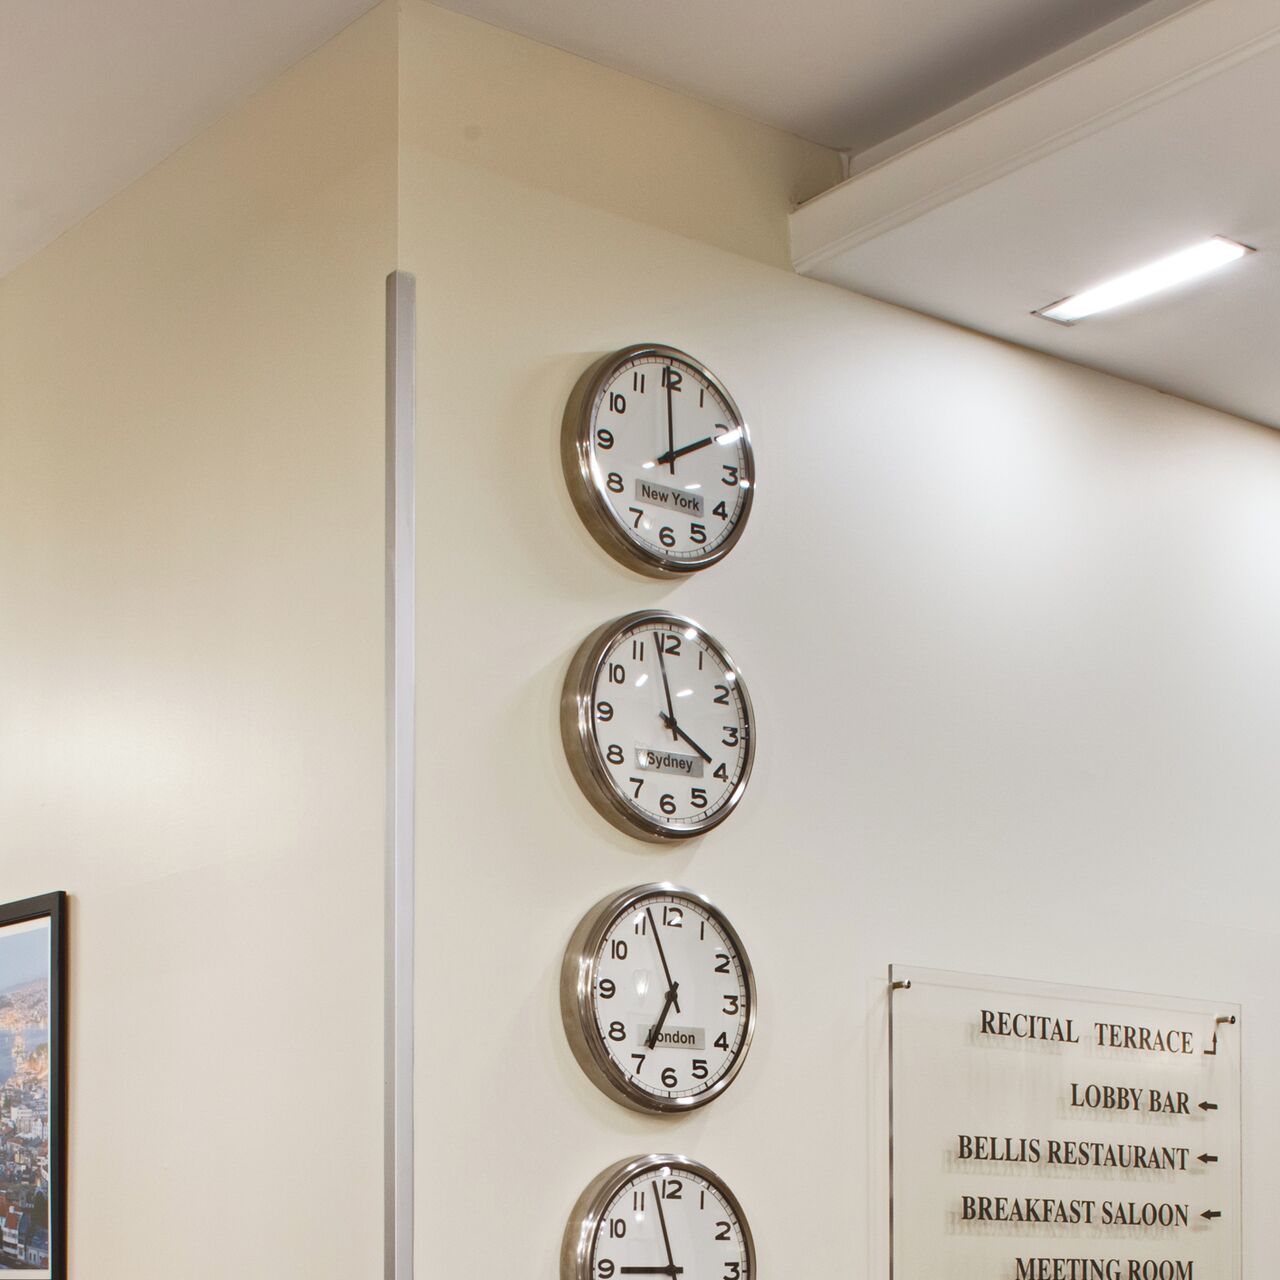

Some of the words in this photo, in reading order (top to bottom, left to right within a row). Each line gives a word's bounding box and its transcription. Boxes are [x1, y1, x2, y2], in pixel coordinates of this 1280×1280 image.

[633, 372, 645, 393] 11
[662, 366, 683, 392] 12
[610, 392, 626, 414] 10
[699, 389, 704, 408] 1
[597, 429, 614, 450] 9
[606, 472, 624, 493] 8
[722, 465, 738, 486] 3
[642, 485, 669, 503] New
[673, 492, 700, 512] York
[629, 507, 643, 528] 7
[712, 501, 728, 520] 4
[659, 527, 676, 547] 6
[689, 523, 707, 544] 5
[633, 640, 644, 661] 11
[660, 633, 681, 656] 12
[699, 651, 703, 670] 1
[609, 663, 625, 684] 10
[714, 685, 730, 705] 2
[596, 701, 614, 722] 9
[722, 726, 738, 747] 3
[607, 744, 624, 765] 8
[647, 752, 693, 773] Sydney
[713, 763, 728, 783] 4
[629, 777, 644, 798] 7
[691, 788, 708, 808] 5
[659, 794, 676, 815] 6
[663, 906, 684, 927] 12
[700, 921, 704, 940] 1
[612, 940, 628, 960] 10
[714, 954, 730, 973] 2
[599, 979, 616, 999] 9
[722, 995, 738, 1015] 3
[608, 1021, 626, 1041] 8
[713, 1032, 729, 1051] 4
[980, 1009, 1079, 1043] RECITAL
[1094, 1022, 1194, 1054] TERRACE
[631, 1054, 646, 1074] 7
[692, 1059, 708, 1079] 5
[661, 1067, 678, 1088] 6
[1070, 1083, 1143, 1111] LOBBY
[1149, 1089, 1190, 1114] BAR
[958, 1135, 1040, 1163] BELLIS
[1047, 1140, 1189, 1170] RESTAURANT
[662, 1179, 682, 1200] 12
[700, 1191, 704, 1209] 1
[633, 1191, 645, 1211] 11
[961, 1196, 1095, 1224] BREAKFAST
[1101, 1202, 1189, 1227] SALOON
[610, 1219, 626, 1238] 10
[715, 1221, 731, 1240] 2
[597, 1259, 615, 1279] 9
